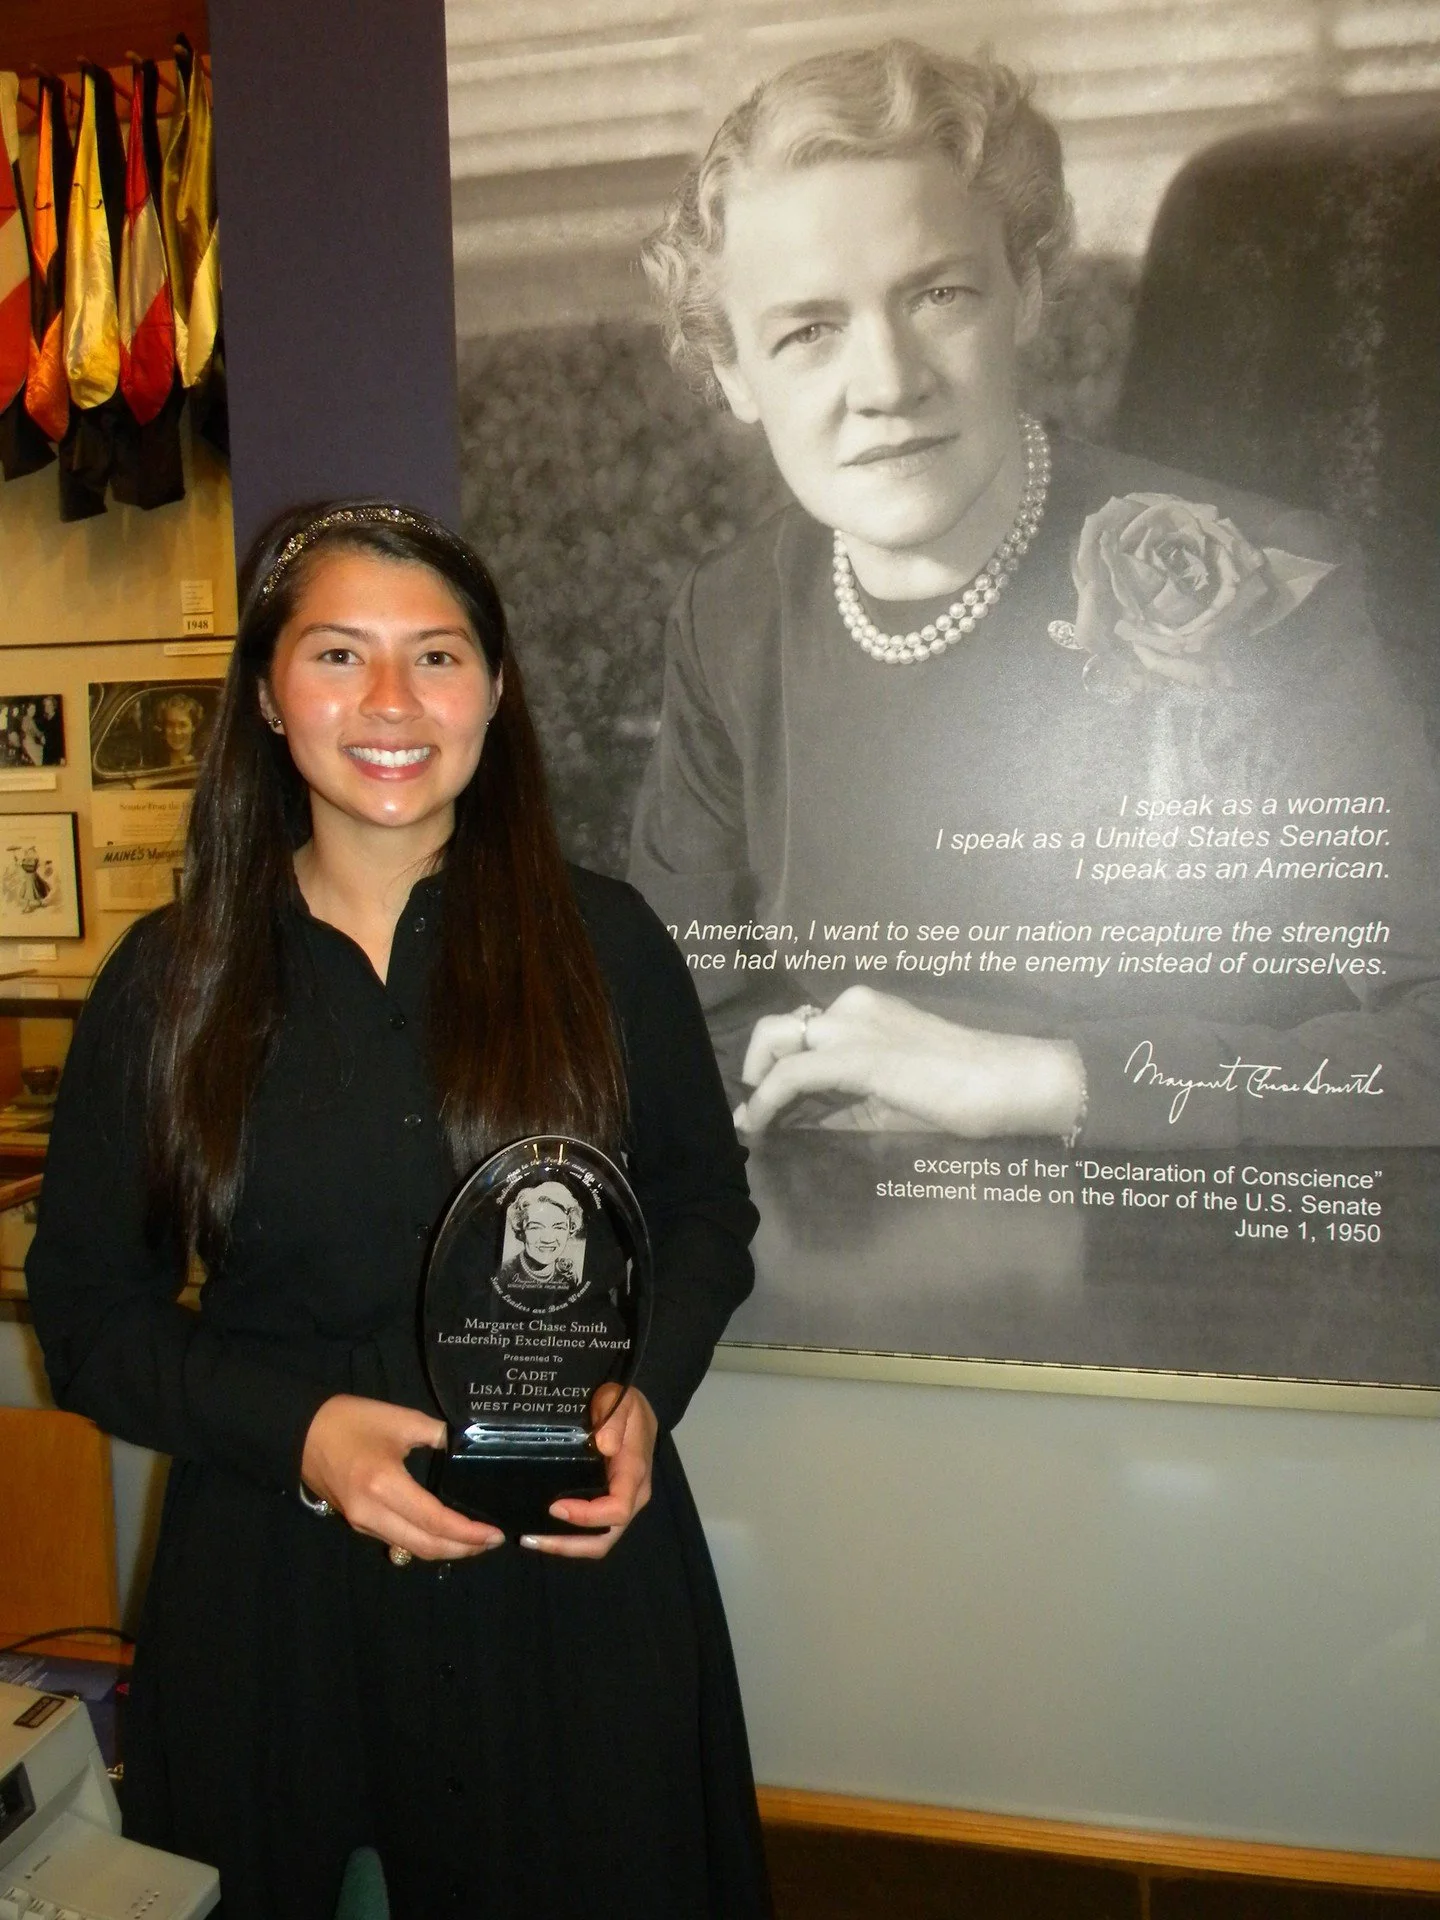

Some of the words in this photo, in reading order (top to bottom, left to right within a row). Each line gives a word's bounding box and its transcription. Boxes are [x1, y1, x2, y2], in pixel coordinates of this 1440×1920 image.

[187, 620, 209, 631] 1948
[1120, 795, 1128, 816] I
[1135, 794, 1214, 821] speak
[1221, 798, 1253, 816] as
[1261, 798, 1278, 815] a
[1287, 796, 1391, 815] woman.
[935, 828, 944, 850] I
[950, 827, 1025, 855] speak
[1032, 832, 1063, 849] as
[1070, 832, 1086, 849] a
[1095, 826, 1179, 849] United
[1187, 825, 1271, 848] States
[1279, 824, 1390, 847] Senator.
[1075, 858, 1084, 880] I
[1091, 858, 1168, 885] speak
[1176, 863, 1207, 880] as
[1215, 862, 1248, 880] an
[1254, 856, 1389, 879] American.
[666, 924, 679, 940] n
[683, 919, 799, 945] American,
[808, 919, 816, 941] I
[823, 920, 881, 941] want
[886, 920, 909, 941] to
[916, 925, 960, 942] see
[968, 925, 1011, 942] our
[1015, 921, 1092, 942] nation
[1100, 921, 1223, 947] recapture
[1231, 920, 1273, 943] the
[1280, 920, 1390, 948] strength
[686, 953, 726, 970] nce
[733, 948, 778, 971] had
[784, 949, 847, 971] when
[854, 954, 888, 971] we
[895, 949, 973, 977] fought
[979, 950, 1017, 972] the
[1025, 955, 1111, 978] enemy
[1117, 951, 1213, 974] instead
[1219, 951, 1249, 974] of
[1252, 952, 1387, 975] ourselves.
[1302, 1058, 1384, 1095] Smith
[913, 1157, 1002, 1179] excerpts
[1007, 1158, 1029, 1177] of
[1034, 1158, 1070, 1178] her
[1212, 1165, 1236, 1185] of
[876, 1179, 977, 1201] statement
[983, 1184, 1042, 1203] made
[1048, 1189, 1075, 1204] on
[1081, 1186, 1115, 1206] the
[1121, 1187, 1170, 1208] floor
[1175, 1190, 1199, 1209] of
[1202, 1191, 1238, 1211] the
[1245, 1192, 1293, 1213] U.S.
[1300, 1194, 1382, 1217] Senate
[1234, 1218, 1289, 1239] June
[1297, 1221, 1316, 1243] 1,
[1325, 1222, 1381, 1243] 1950
[502, 1294, 531, 1313] Leaders
[548, 1302, 569, 1313] Born
[464, 1317, 525, 1334] Margaret
[528, 1319, 567, 1332] Chase
[570, 1321, 608, 1333] Smith
[437, 1332, 511, 1347] Leadership
[515, 1334, 586, 1348] Excellence
[588, 1337, 631, 1350] Award
[503, 1353, 550, 1363] Presented
[553, 1354, 563, 1363] To
[506, 1367, 558, 1382] CADET
[469, 1382, 503, 1396] LISA
[505, 1383, 517, 1396] J.
[521, 1383, 591, 1398] DELACEY
[470, 1401, 509, 1411] WEST
[512, 1401, 554, 1412] POINT
[556, 1403, 587, 1414] 2017
